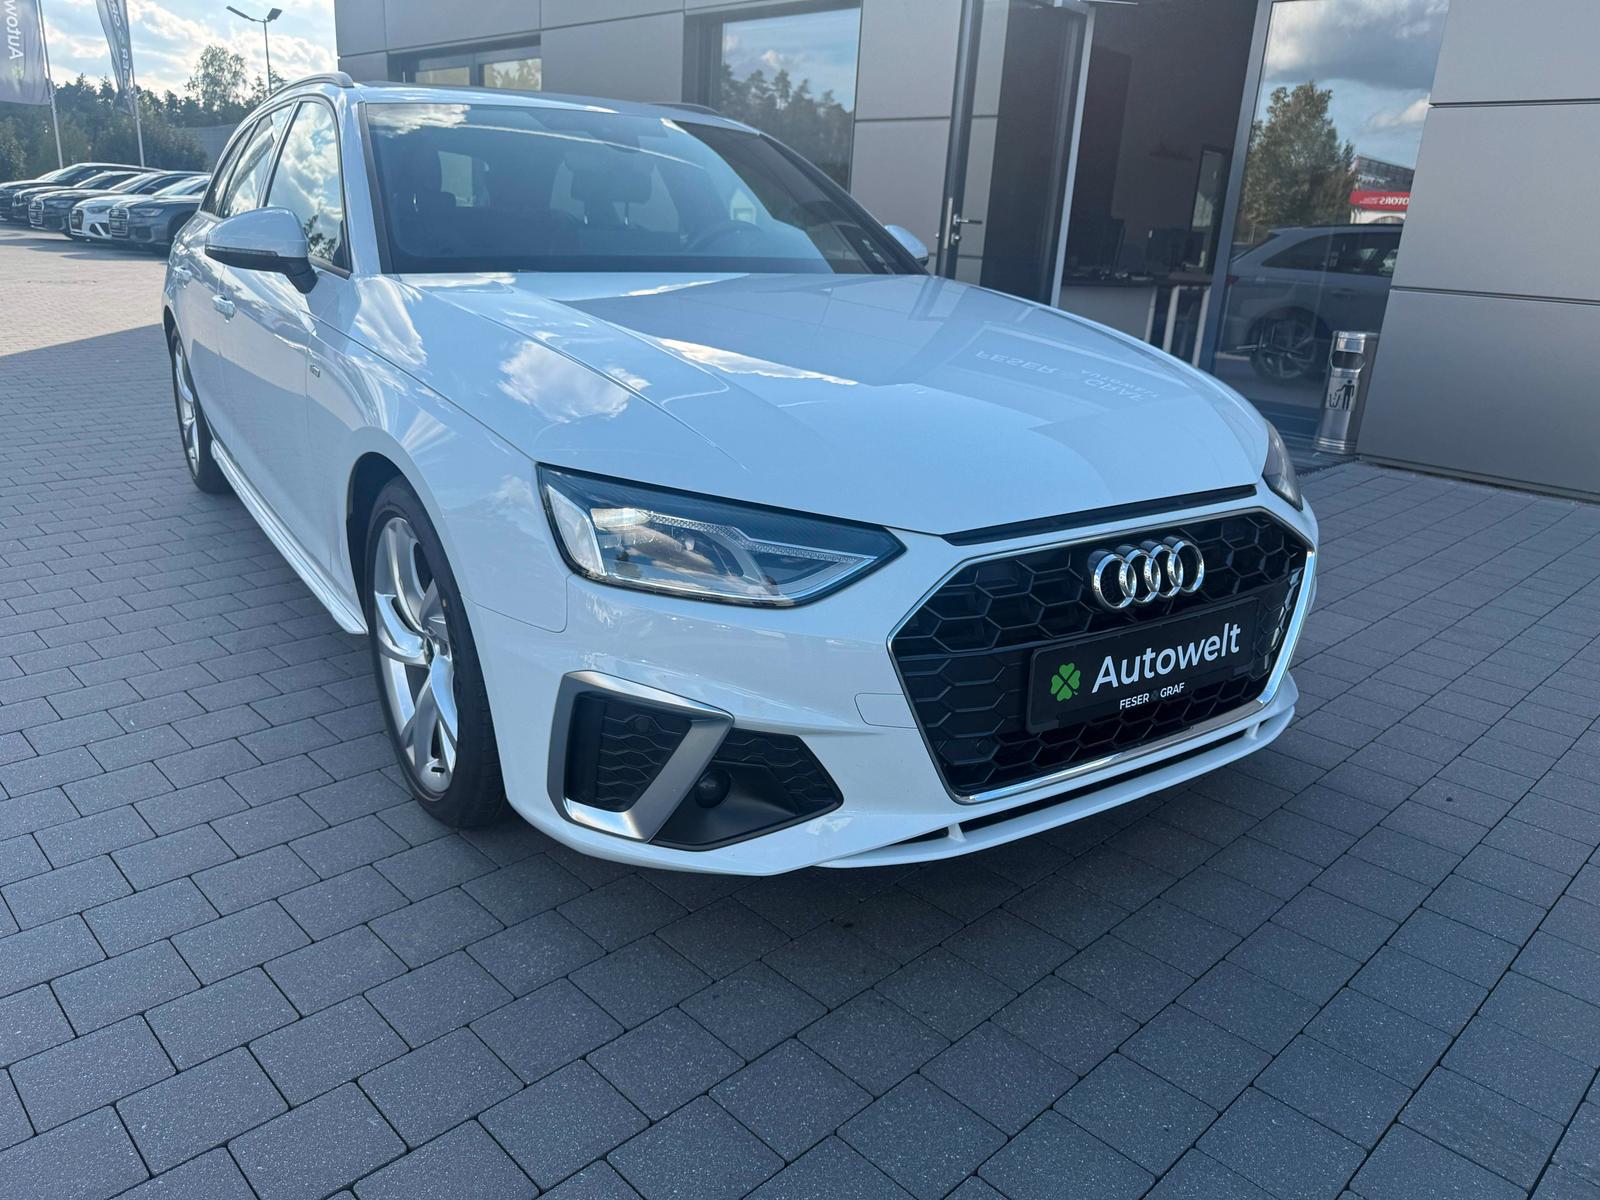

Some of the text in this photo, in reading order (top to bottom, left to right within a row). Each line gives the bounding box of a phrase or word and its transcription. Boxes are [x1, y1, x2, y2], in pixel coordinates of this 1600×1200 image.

[1091, 622, 1241, 694] Autowelt
[1119, 682, 1185, 710] FESER GRAF
